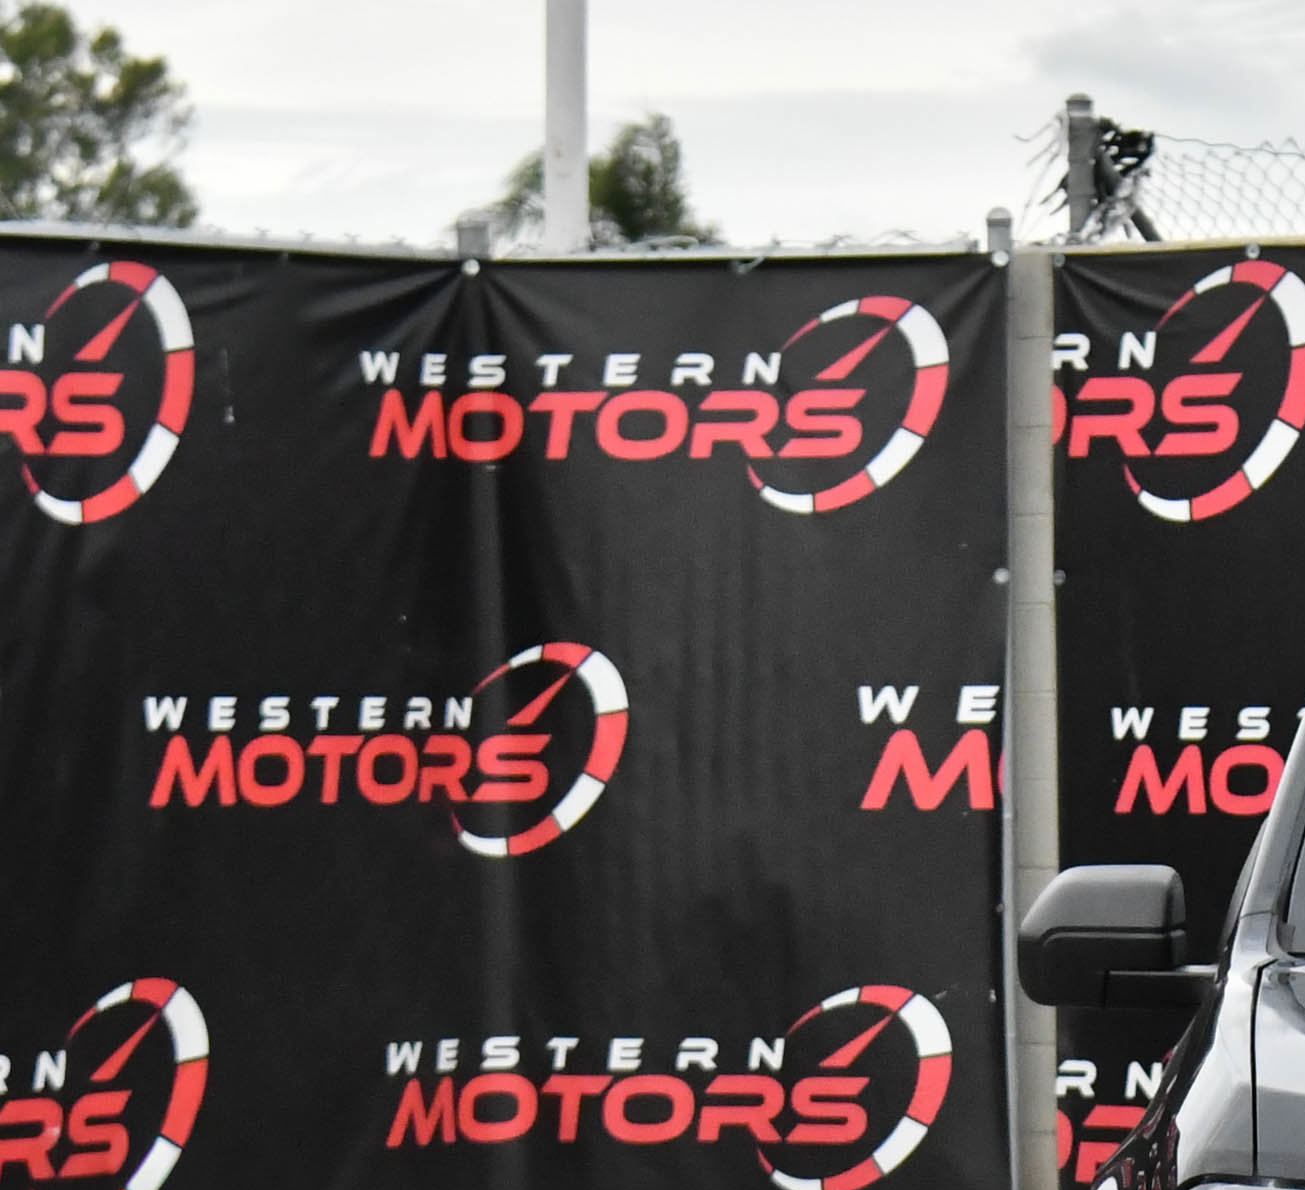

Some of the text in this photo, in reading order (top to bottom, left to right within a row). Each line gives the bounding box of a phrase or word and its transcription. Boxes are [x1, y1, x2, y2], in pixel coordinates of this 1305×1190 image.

[360, 351, 782, 387] WESTERN
[369, 388, 867, 463] MOTORS
[144, 696, 473, 731] WESTERN
[149, 732, 552, 809] MOTORS
[386, 1036, 785, 1076] WESTERN
[386, 1072, 870, 1148] MOTORS
